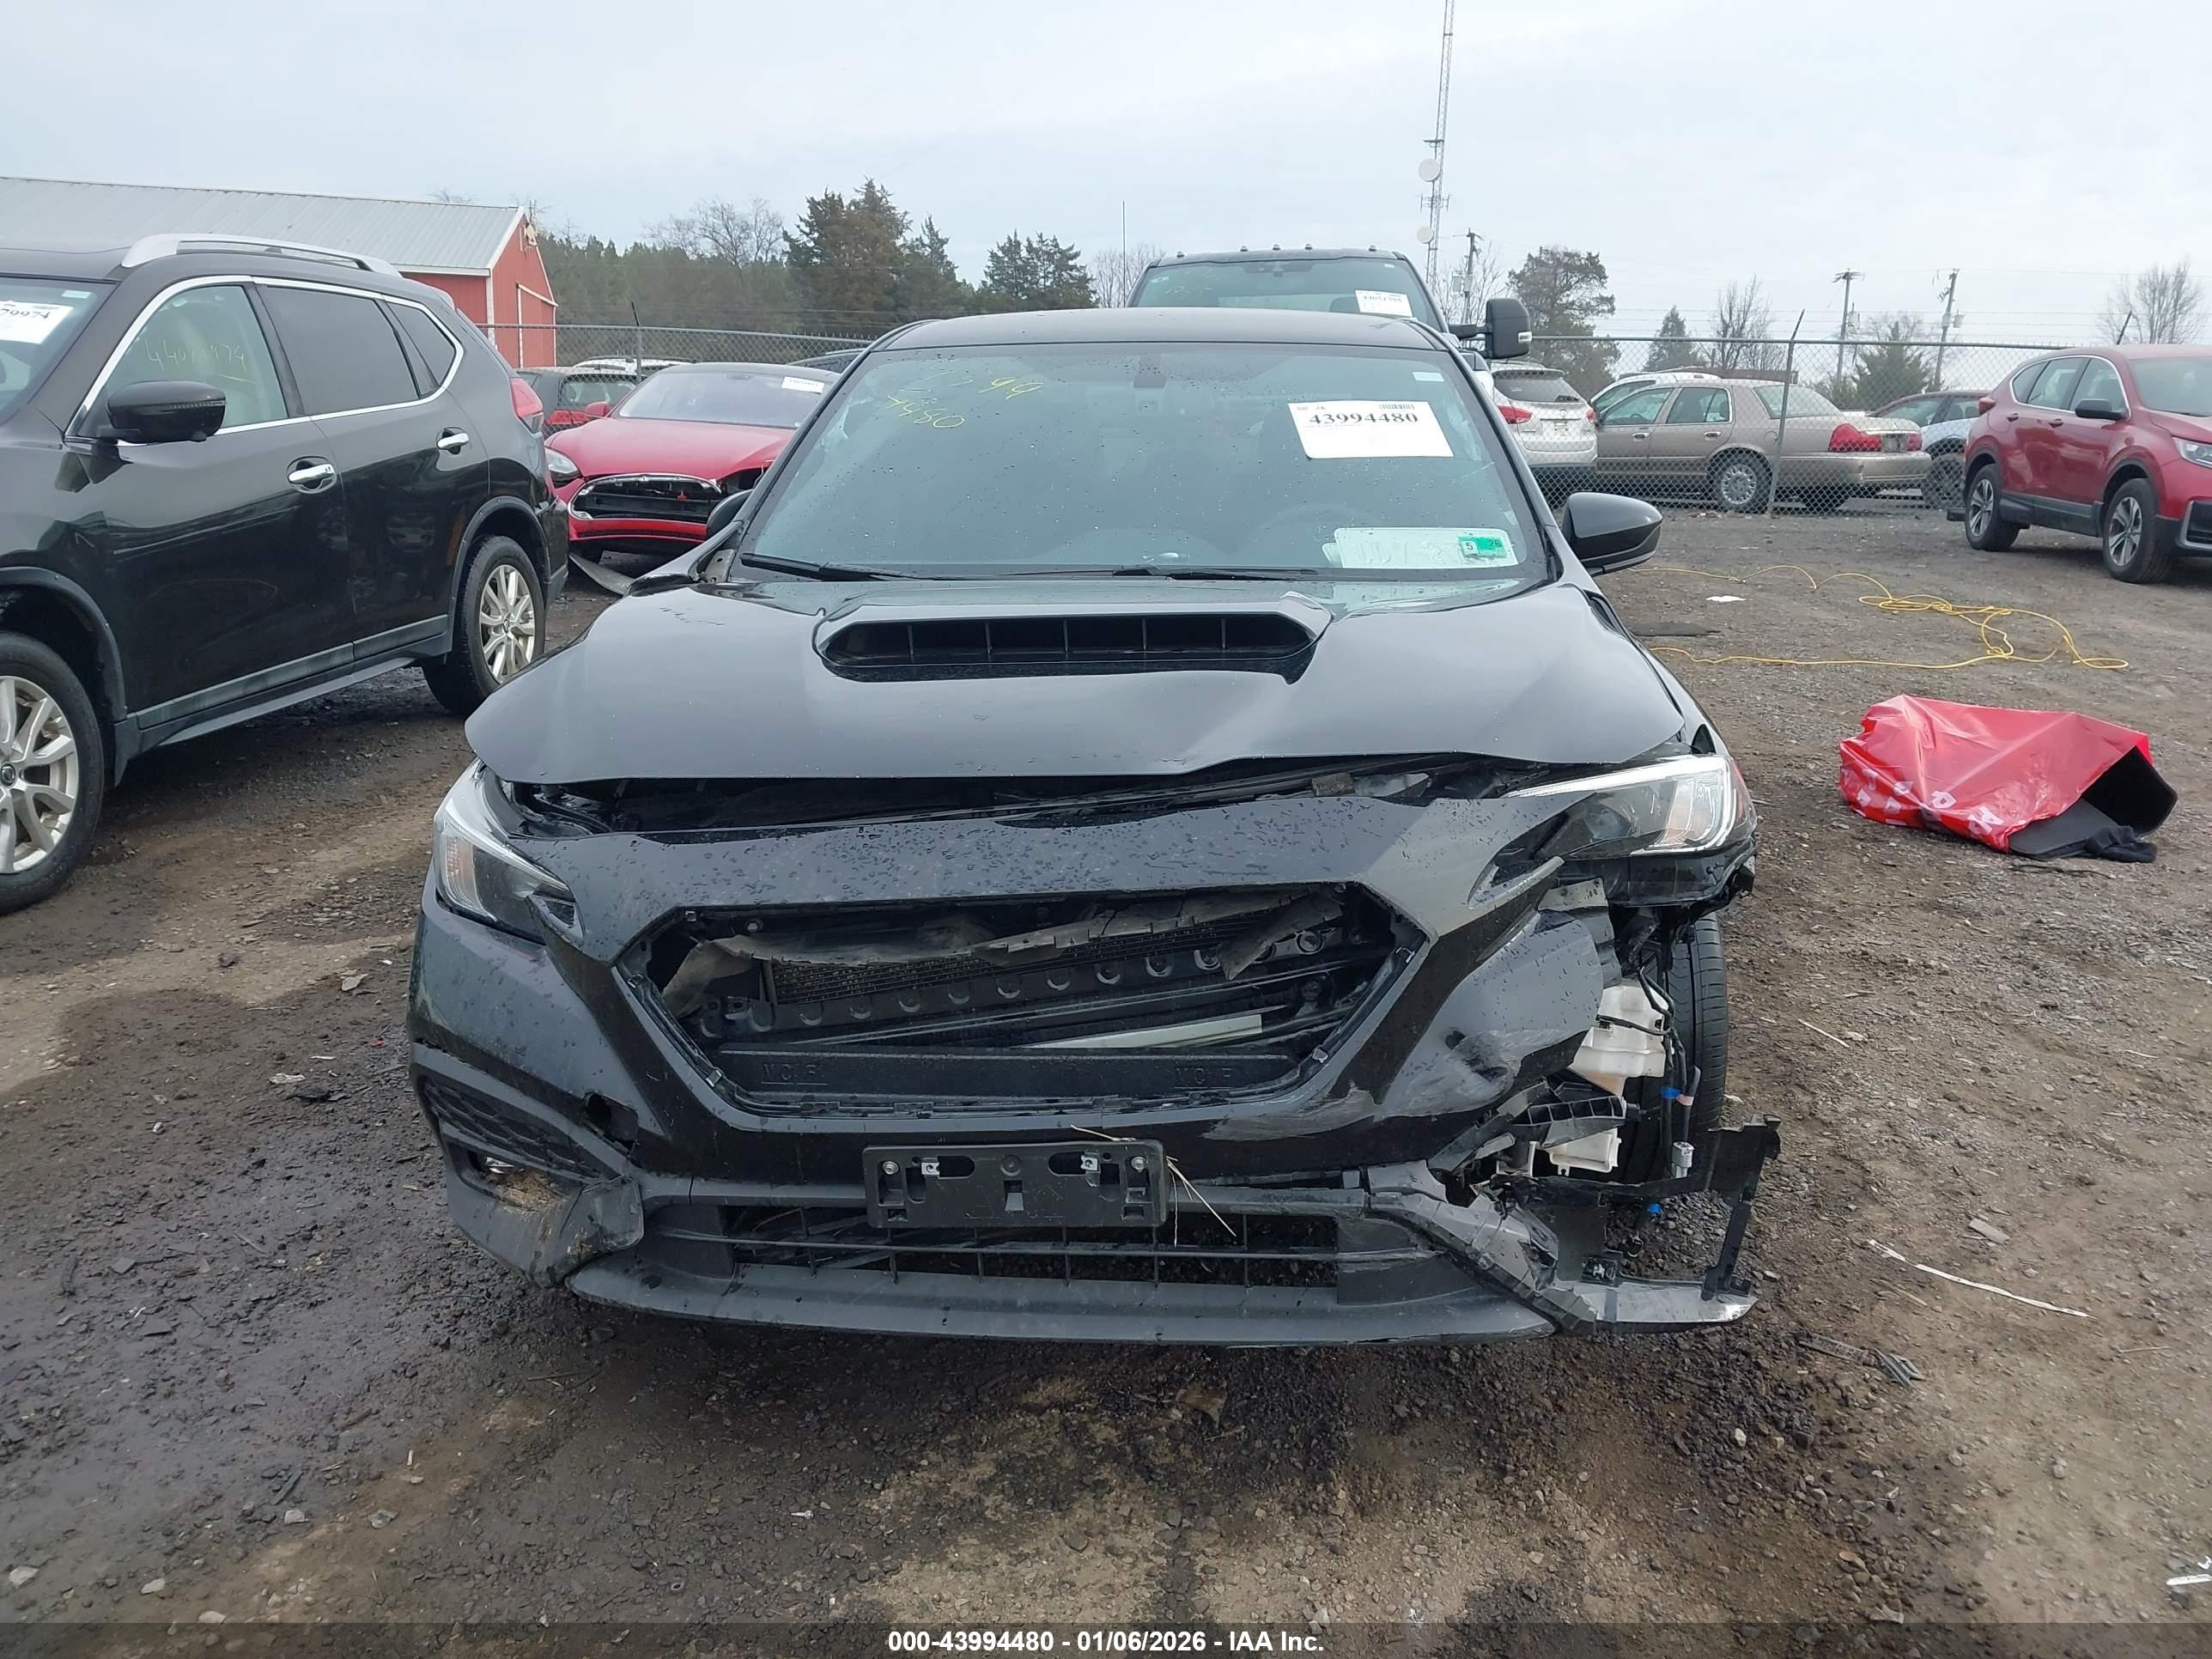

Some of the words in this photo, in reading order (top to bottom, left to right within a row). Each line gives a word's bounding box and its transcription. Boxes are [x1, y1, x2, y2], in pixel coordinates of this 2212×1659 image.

[144, 338, 247, 372] 440974
[1309, 412, 1419, 424] 43994480
[1465, 542, 1474, 550] 5
[1488, 538, 1501, 547] 26
